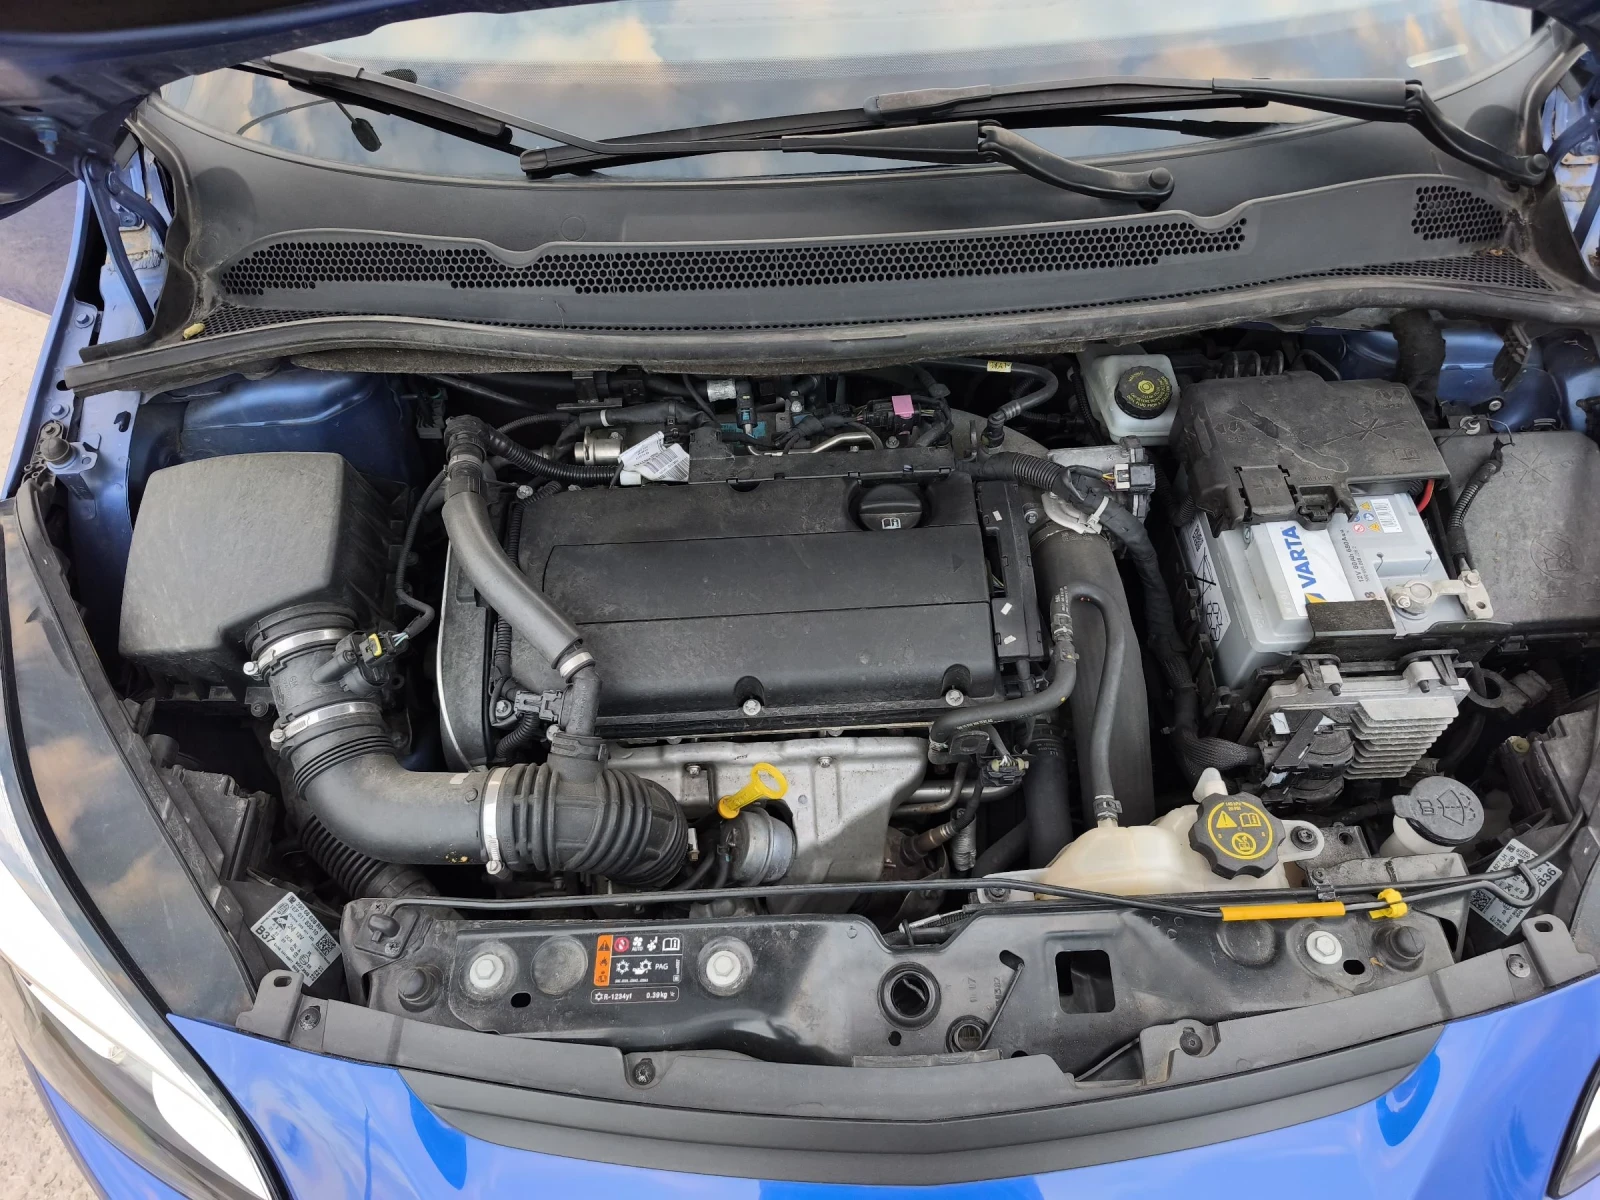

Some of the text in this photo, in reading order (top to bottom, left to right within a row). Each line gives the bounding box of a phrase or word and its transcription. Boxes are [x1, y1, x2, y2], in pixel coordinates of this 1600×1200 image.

[1282, 526, 1316, 588] VARTA
[1356, 570, 1364, 582] 12V
[1538, 868, 1556, 887] B36
[256, 926, 275, 942] B37
[604, 992, 632, 1001] R-1234yf
